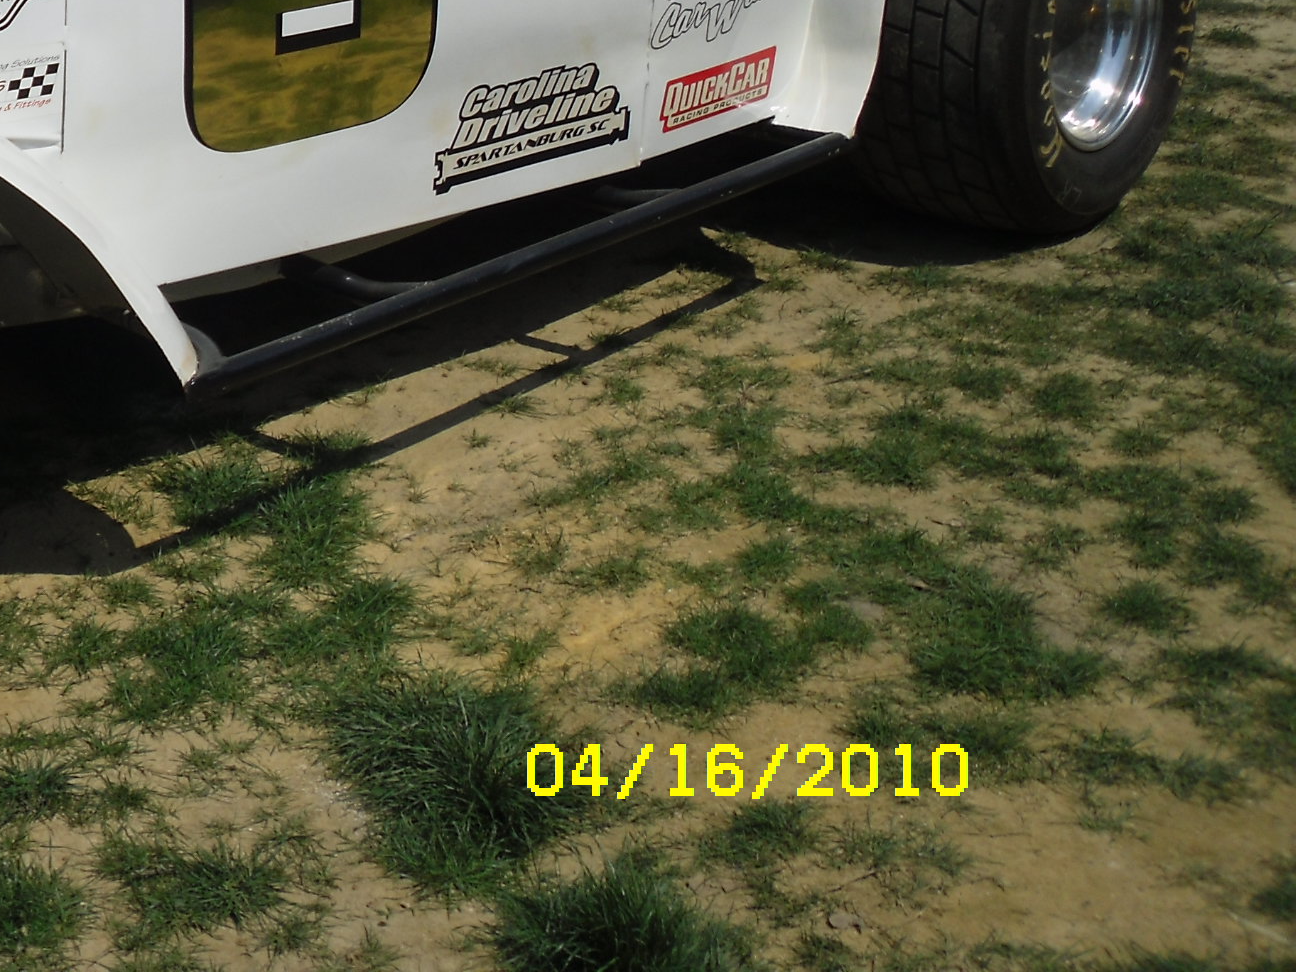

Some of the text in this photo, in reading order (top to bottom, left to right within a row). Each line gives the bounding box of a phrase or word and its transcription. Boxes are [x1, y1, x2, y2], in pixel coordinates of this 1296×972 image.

[10, 54, 61, 69] Solutions
[13, 97, 52, 111] Fittings
[460, 63, 598, 119] Carolina
[672, 88, 764, 125] RACING PRODUCTS
[452, 86, 618, 150] Driveline
[453, 118, 611, 170] SPARTANBURG SC
